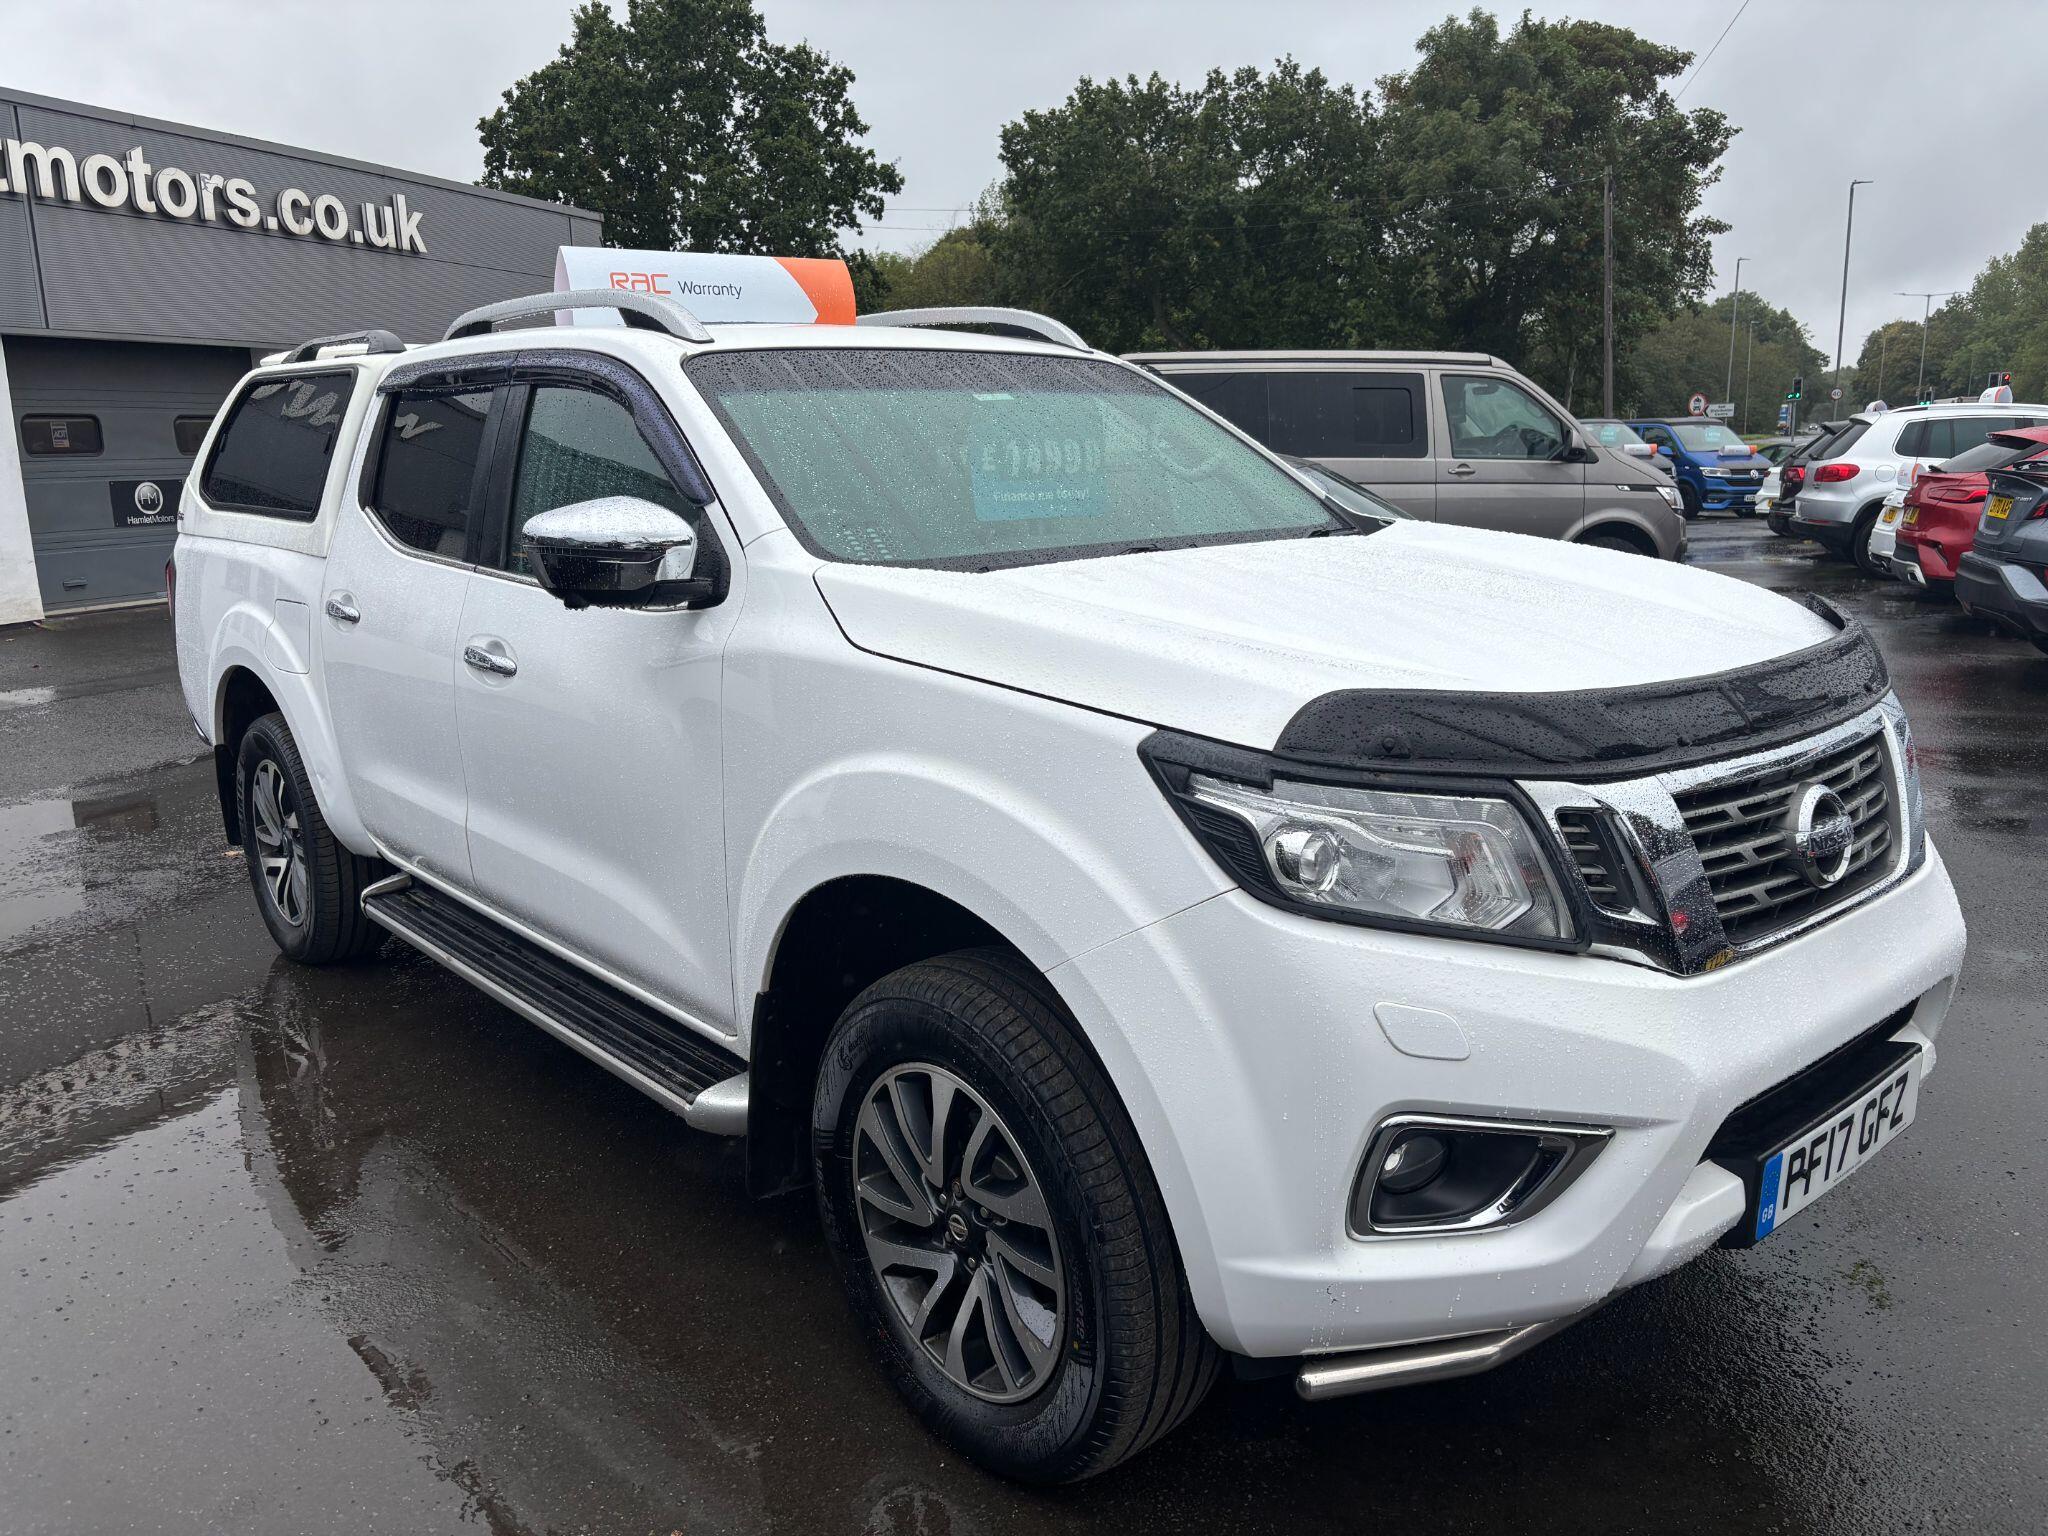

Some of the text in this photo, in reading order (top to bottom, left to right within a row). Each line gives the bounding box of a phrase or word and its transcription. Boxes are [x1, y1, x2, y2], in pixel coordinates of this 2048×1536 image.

[0, 138, 427, 253] motors.co.uk
[610, 272, 742, 299] RAC Warranty
[1783, 1071, 1909, 1210] PF17 GFZ
[1761, 1203, 1774, 1223] GB
